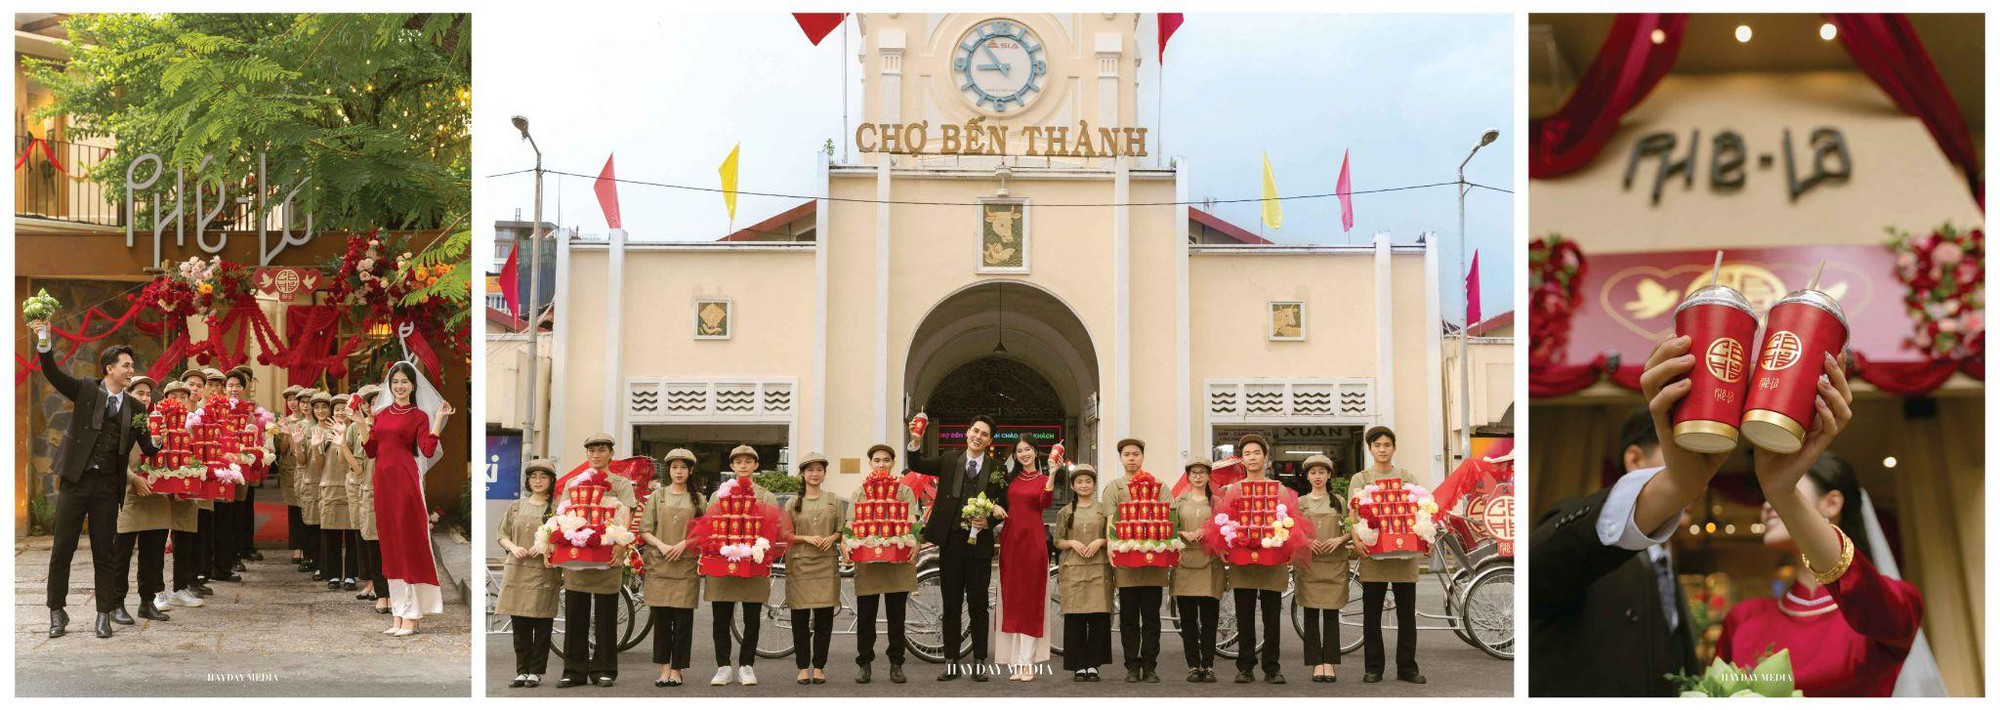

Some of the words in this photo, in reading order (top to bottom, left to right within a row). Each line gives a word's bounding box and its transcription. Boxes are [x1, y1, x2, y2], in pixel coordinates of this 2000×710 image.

[855, 120, 929, 157] CHỢ
[940, 116, 1009, 156] BẾN
[1020, 119, 1148, 157] THÀNH
